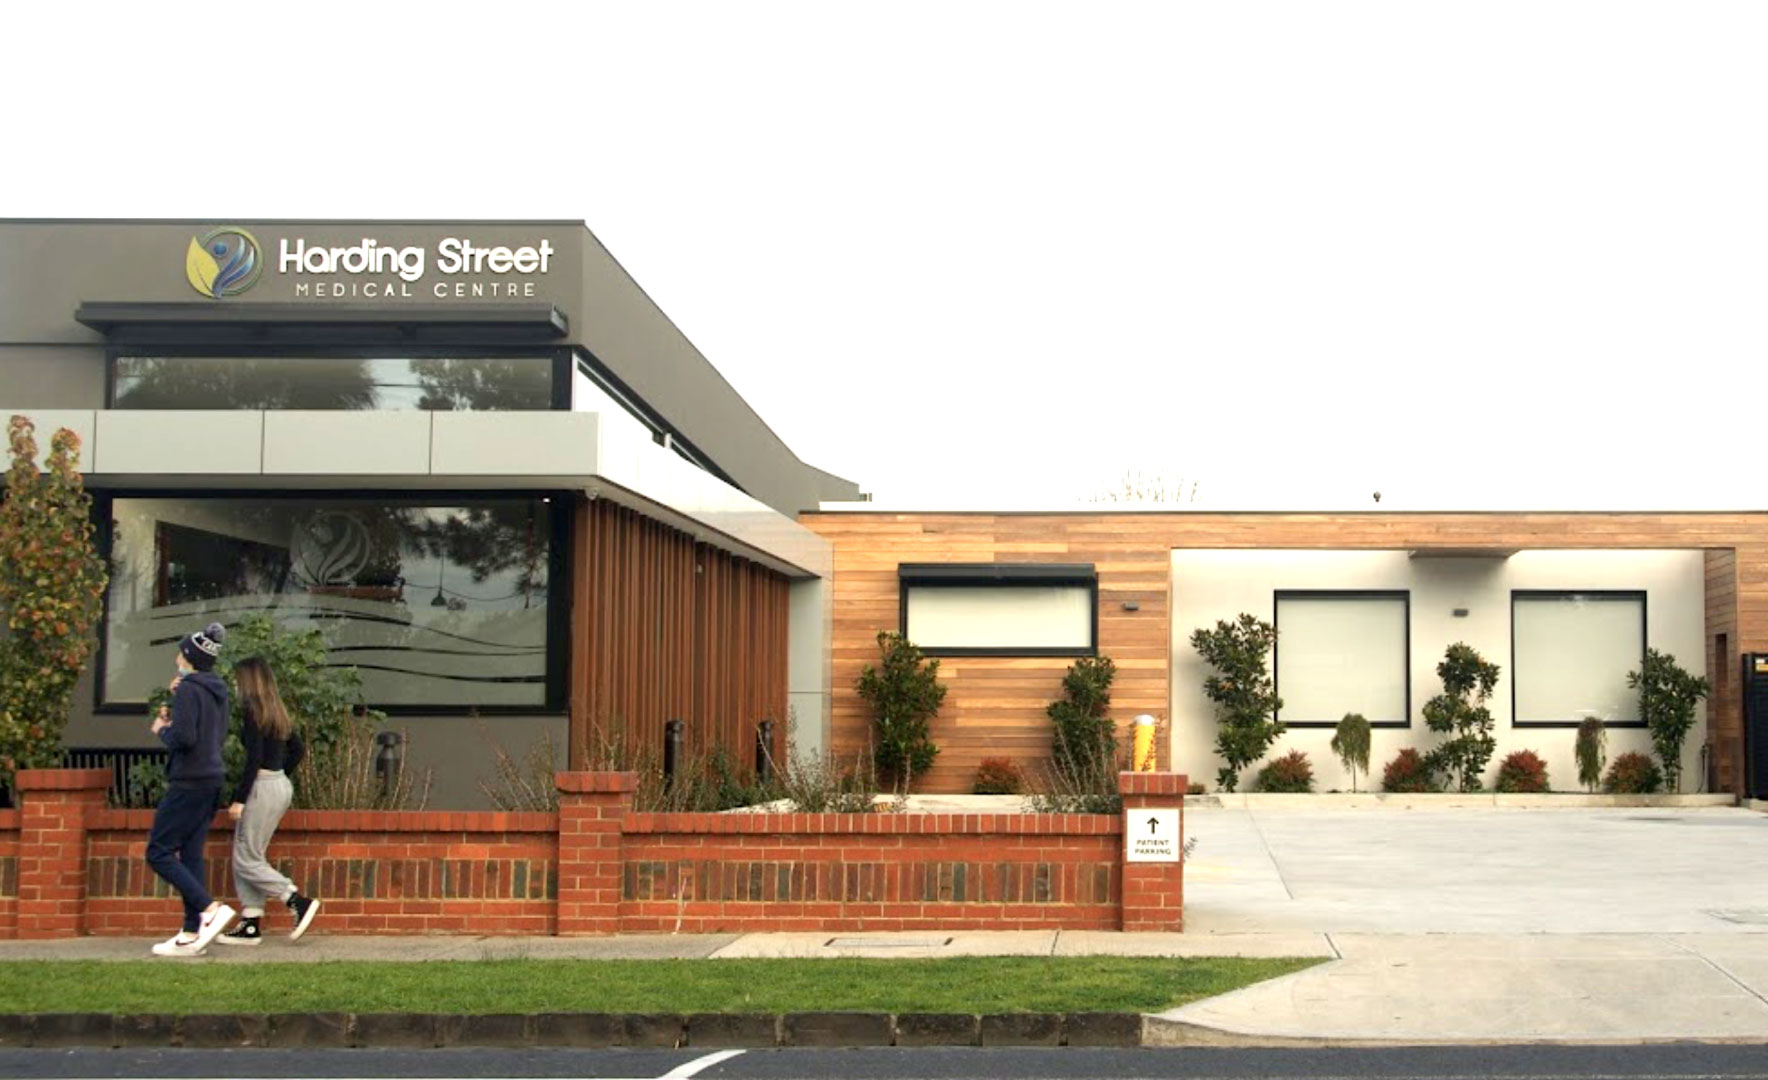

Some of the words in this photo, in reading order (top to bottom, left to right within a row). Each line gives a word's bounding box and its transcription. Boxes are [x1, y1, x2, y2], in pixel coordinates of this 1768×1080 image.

[279, 238, 425, 282] Harding
[437, 237, 554, 273] Street
[295, 282, 413, 298] MEDICAL
[434, 282, 536, 298] CENTRE
